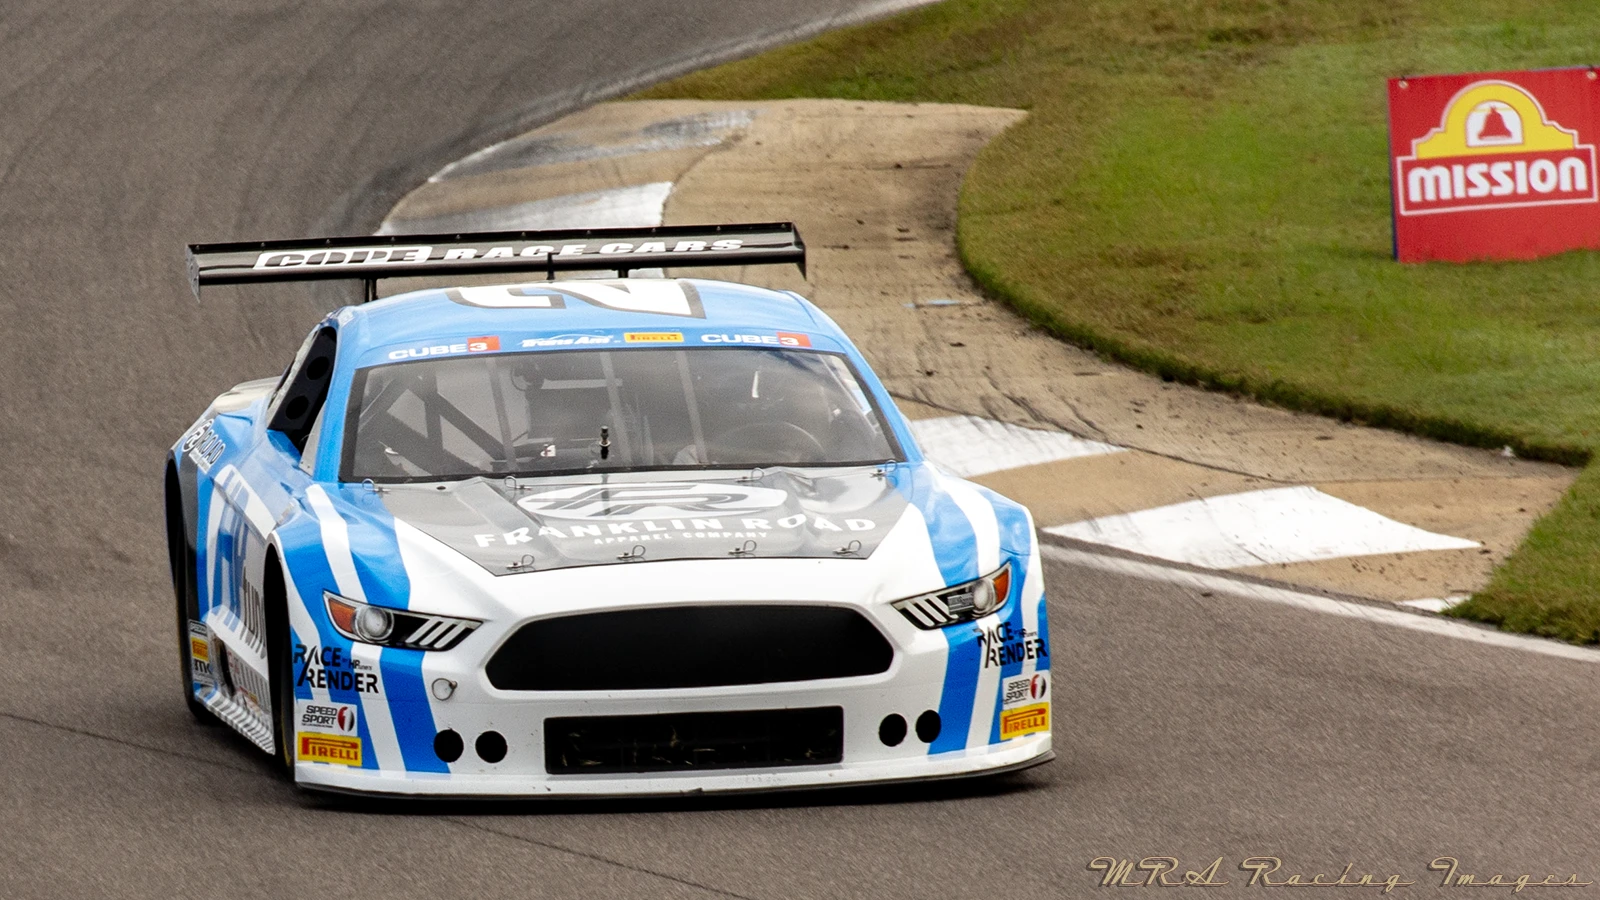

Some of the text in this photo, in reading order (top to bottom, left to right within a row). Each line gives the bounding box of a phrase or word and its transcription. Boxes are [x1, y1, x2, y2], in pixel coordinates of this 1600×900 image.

[1408, 156, 1588, 203] MISSION
[443, 244, 587, 260] RACE
[599, 239, 743, 254] CARS
[474, 513, 877, 548] FRANKLIN ROAD
[594, 533, 672, 545] APPAREL
[293, 643, 342, 667] RACE
[297, 668, 379, 694] RENDER
[302, 714, 336, 725] SPORT
[306, 705, 338, 716] SPEED
[1002, 708, 1046, 734] PIRELLI
[302, 737, 358, 761] PIRELLI
